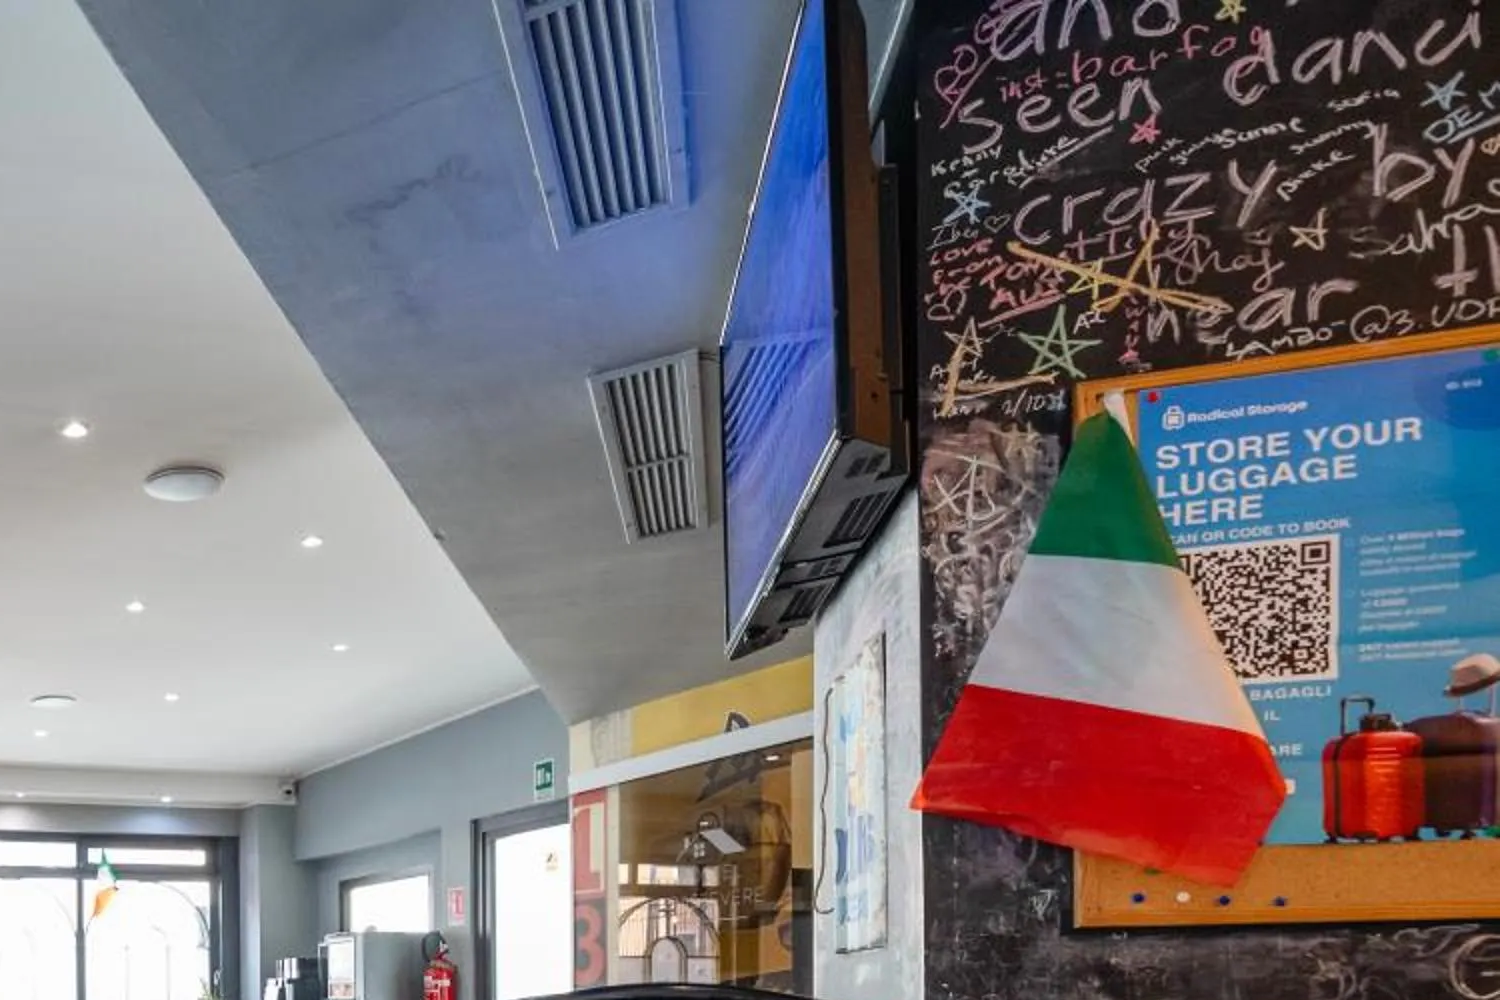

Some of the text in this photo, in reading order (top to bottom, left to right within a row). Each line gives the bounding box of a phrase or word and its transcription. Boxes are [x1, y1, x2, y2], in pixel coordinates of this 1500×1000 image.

[957, 77, 1163, 154] seen
[1013, 158, 1276, 246] crazy
[1372, 122, 1476, 209] by
[1187, 400, 1309, 424] Radical Storage
[1155, 416, 1423, 470] STORE YOUR
[1156, 453, 1358, 500] LUGGAGE
[1157, 493, 1265, 527] HERE
[1228, 525, 1274, 541] CODE
[1277, 522, 1300, 536] TO
[1303, 516, 1351, 533] BOOK
[1249, 684, 1332, 701] BAGAGLI
[1263, 709, 1281, 722] IL
